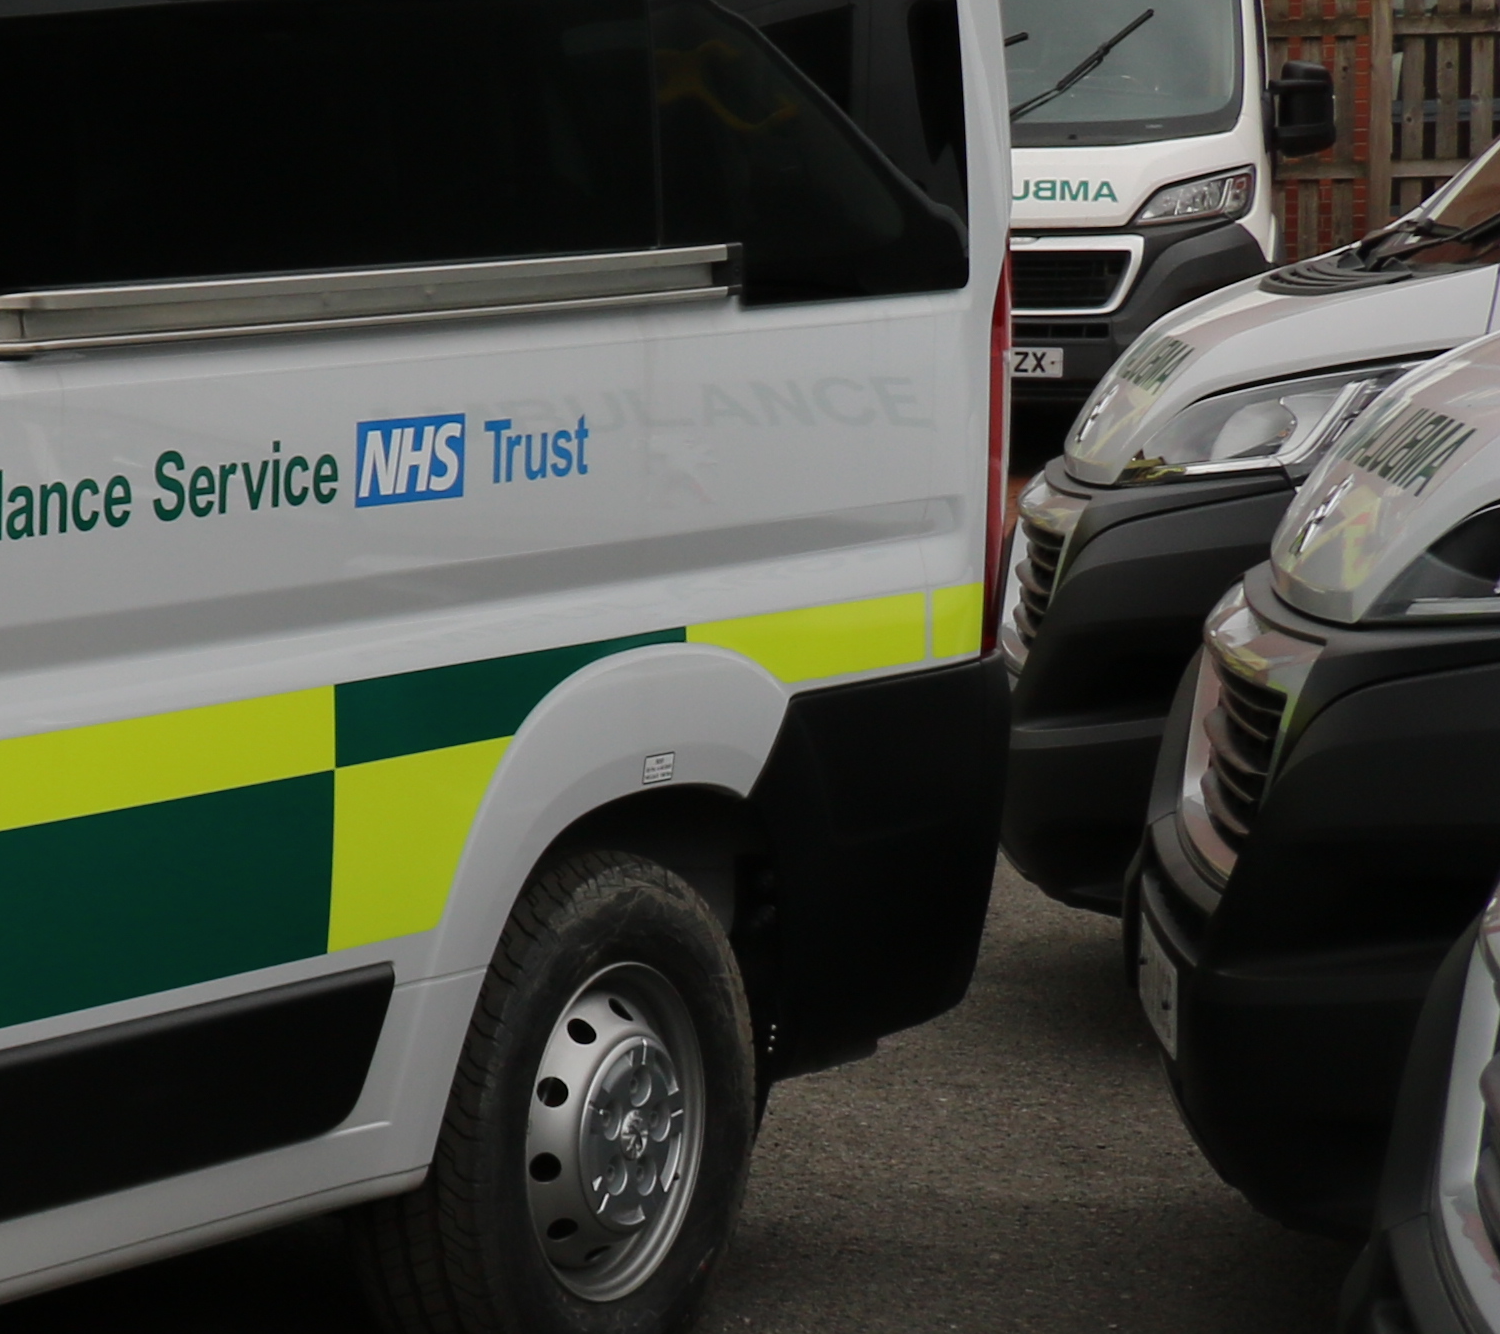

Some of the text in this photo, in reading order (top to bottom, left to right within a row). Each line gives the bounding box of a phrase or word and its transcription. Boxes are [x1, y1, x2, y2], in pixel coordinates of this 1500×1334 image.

[152, 441, 338, 523] Service
[357, 421, 463, 499] NHS
[484, 414, 589, 485] Trust
